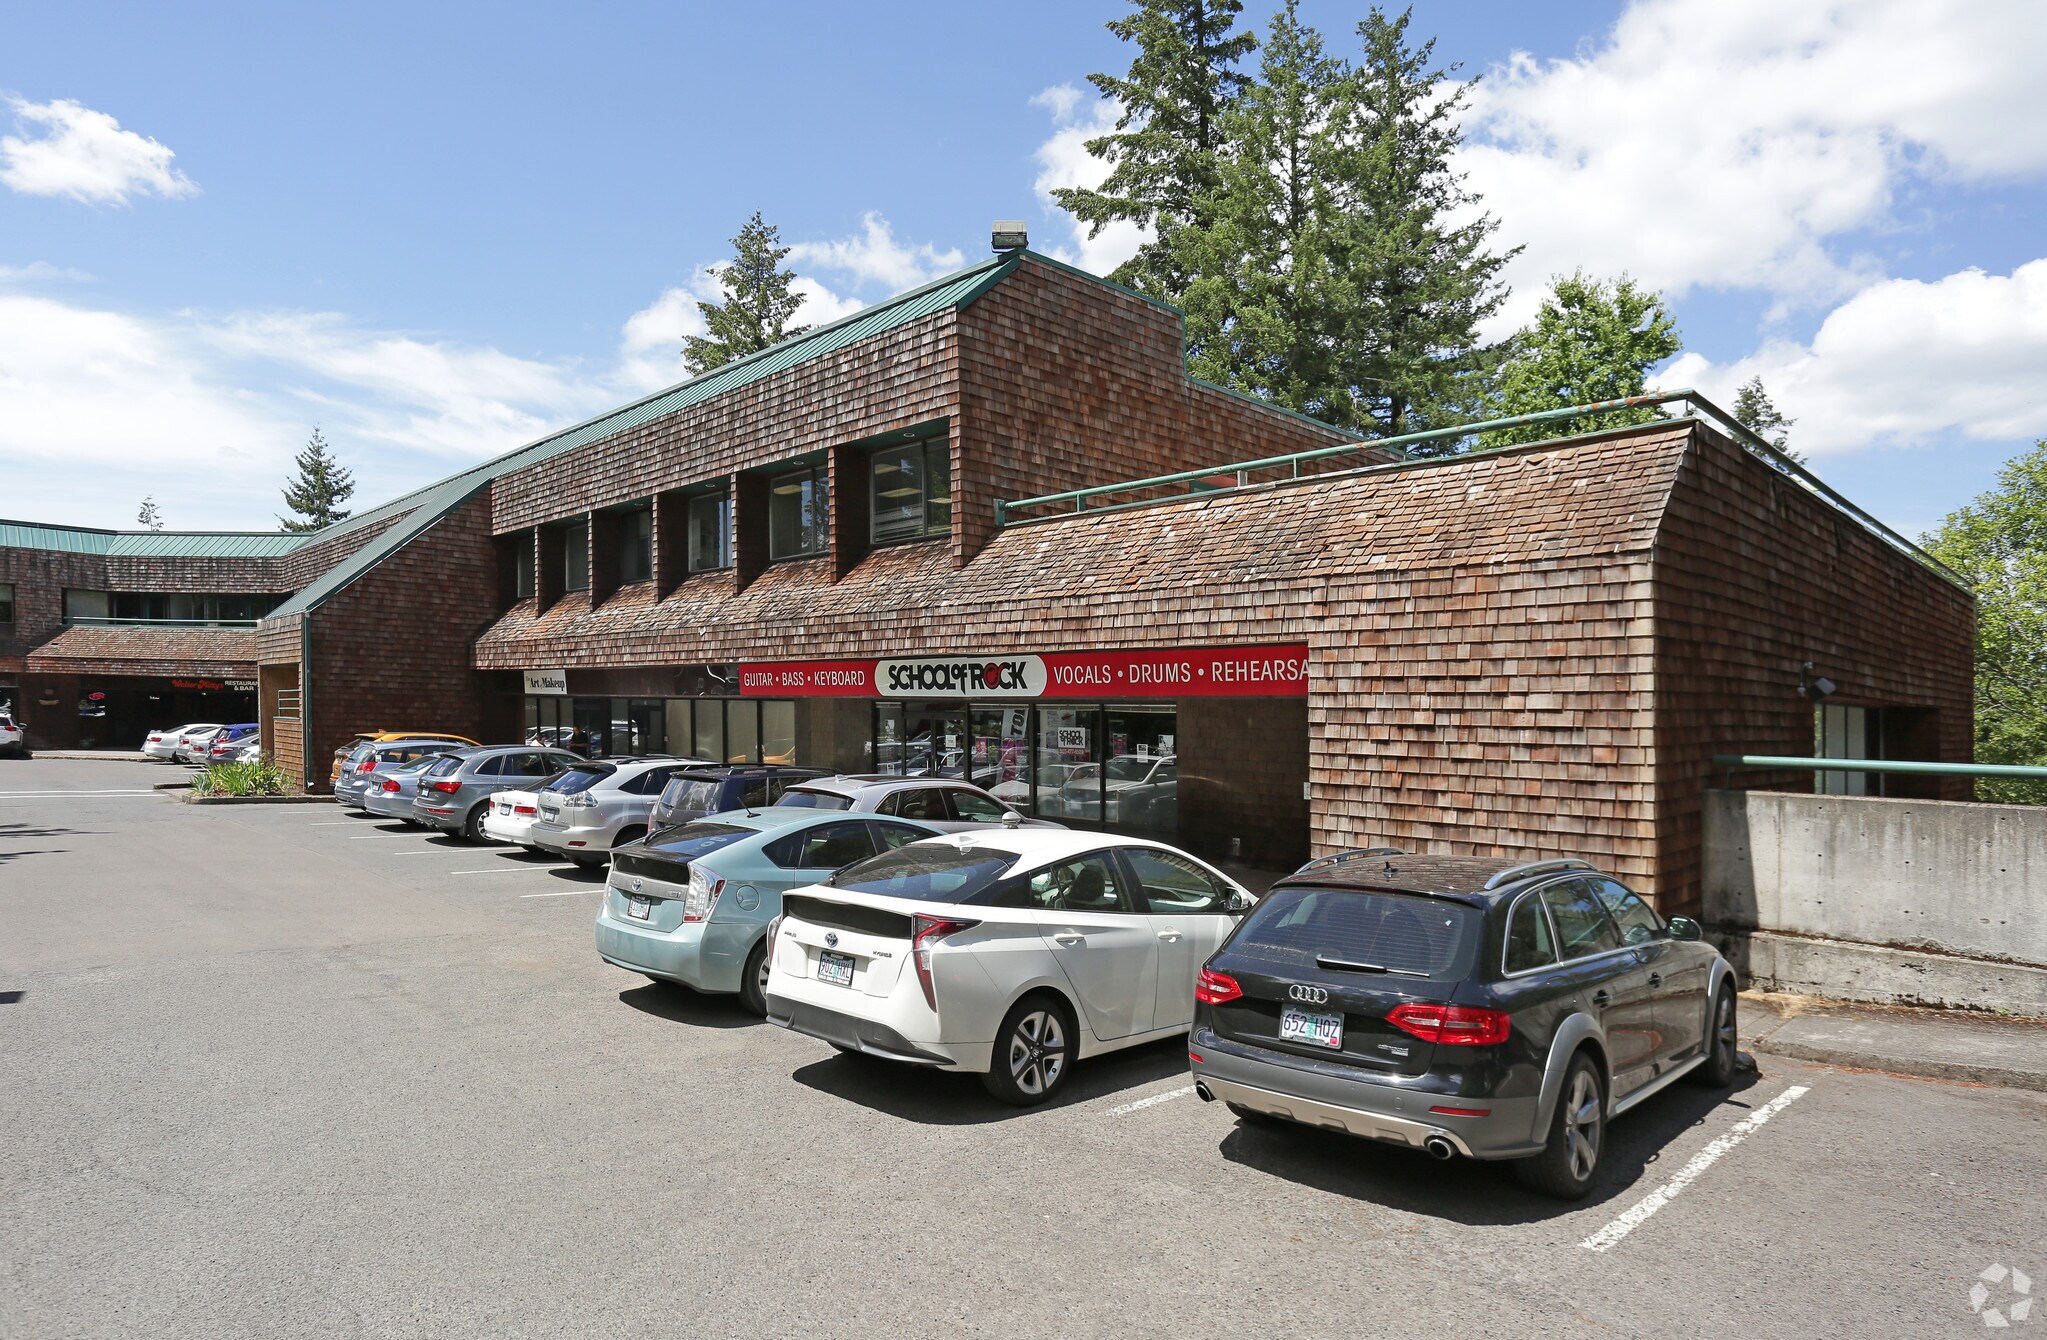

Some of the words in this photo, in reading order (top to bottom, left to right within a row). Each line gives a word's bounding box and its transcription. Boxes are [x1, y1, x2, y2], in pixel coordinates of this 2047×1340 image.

[744, 673, 773, 686] GUITAR
[782, 672, 804, 686] BASS
[814, 670, 865, 686] KEYBOARD
[889, 664, 956, 690] SCHOOL
[968, 661, 1028, 690] ROCK
[1053, 664, 1111, 684] VOCALS
[1129, 662, 1191, 683] DRUMS
[1212, 659, 1308, 682] REHEARSA
[530, 678, 539, 688] Art
[542, 677, 565, 691] Makeup
[821, 958, 834, 975] 902
[1283, 1013, 1307, 1034] 652
[1314, 1018, 1339, 1039] HQZ
